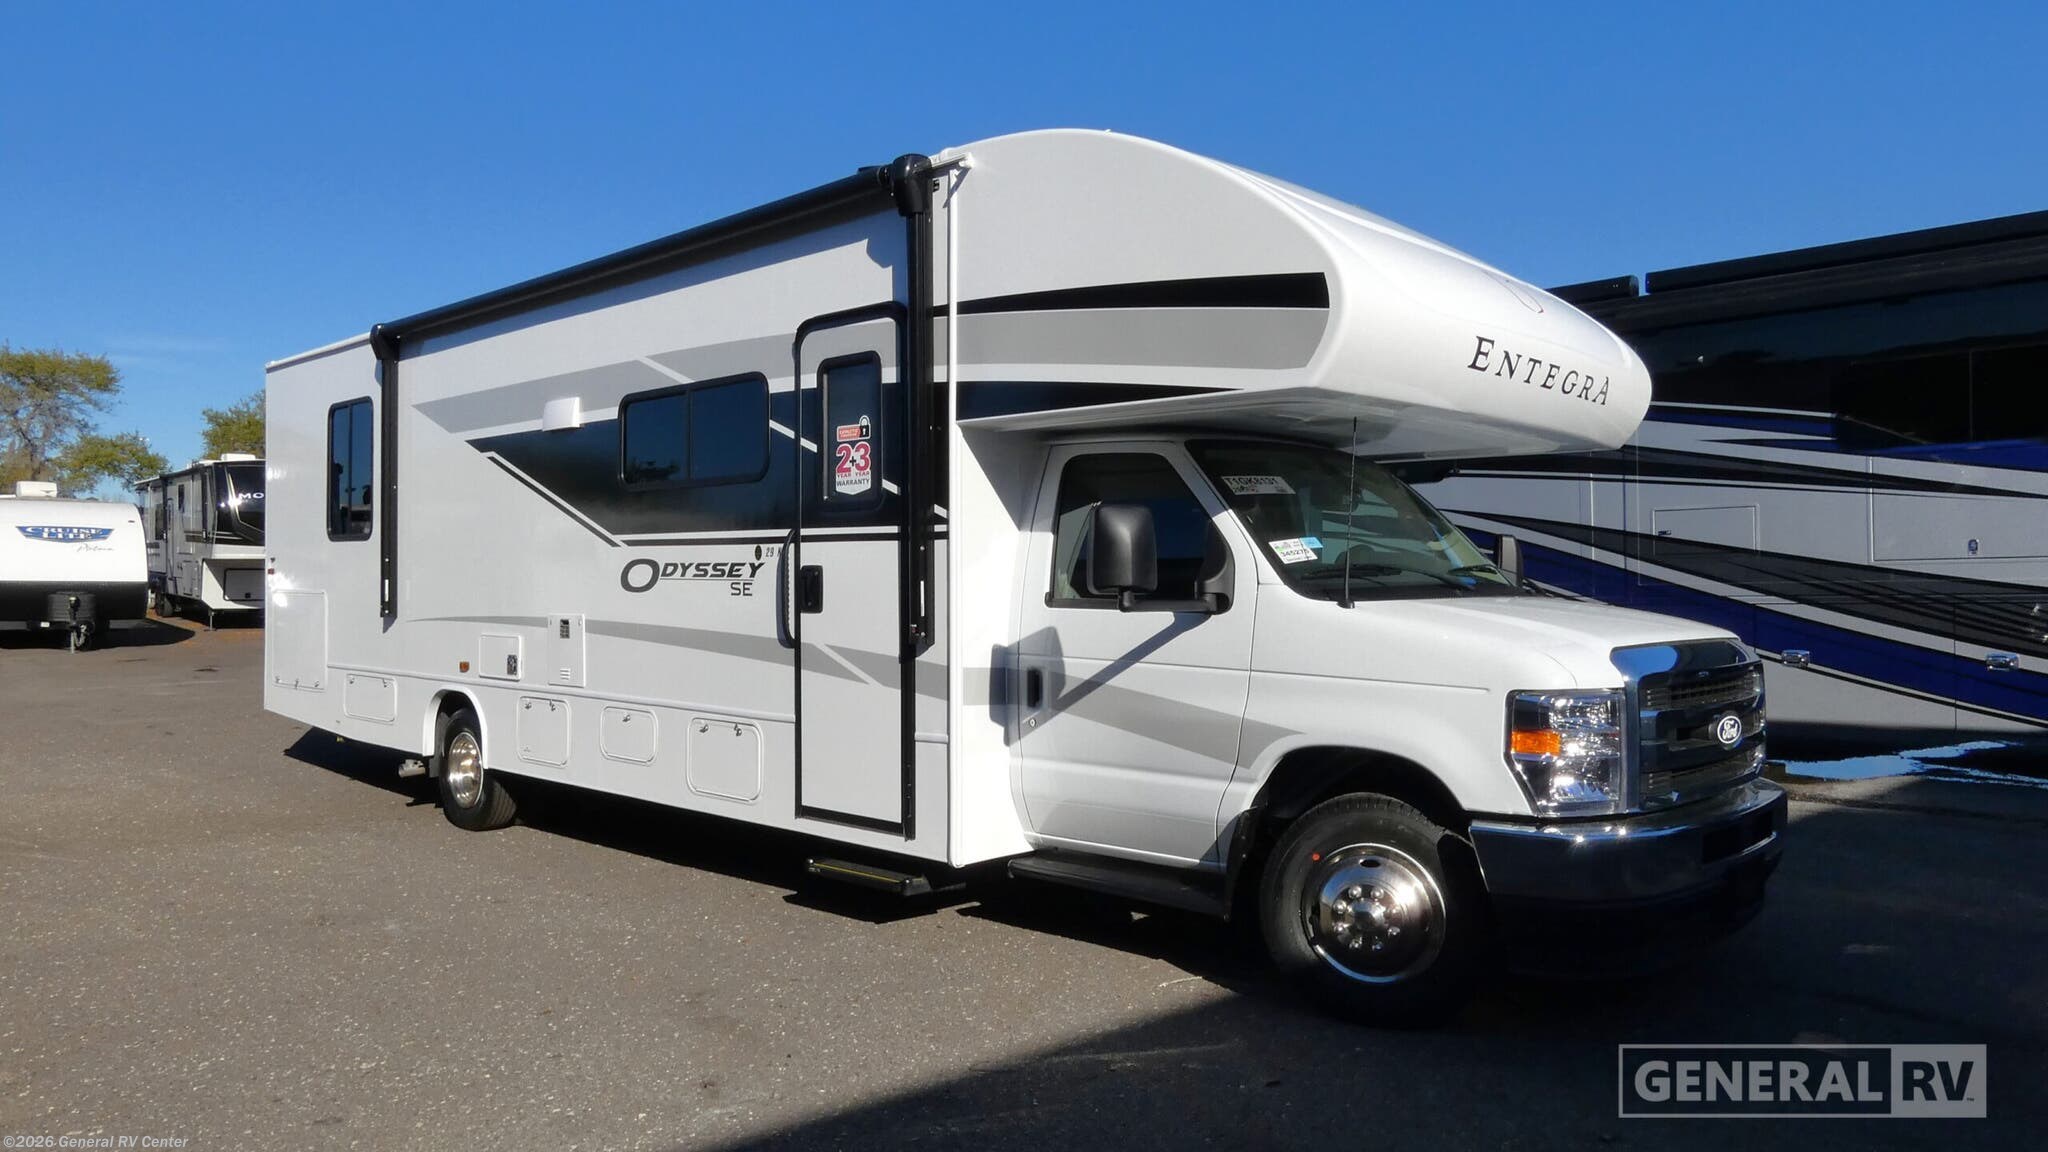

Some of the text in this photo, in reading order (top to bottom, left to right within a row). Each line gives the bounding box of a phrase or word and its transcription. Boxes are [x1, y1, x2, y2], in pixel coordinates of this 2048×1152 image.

[1467, 335, 1610, 406] ENTEGRA
[836, 479, 870, 487] WARRANTY
[25, 527, 103, 535] CRUISE
[42, 532, 93, 540] LITE
[620, 558, 766, 593] ODYSSEY
[730, 582, 753, 597] SE
